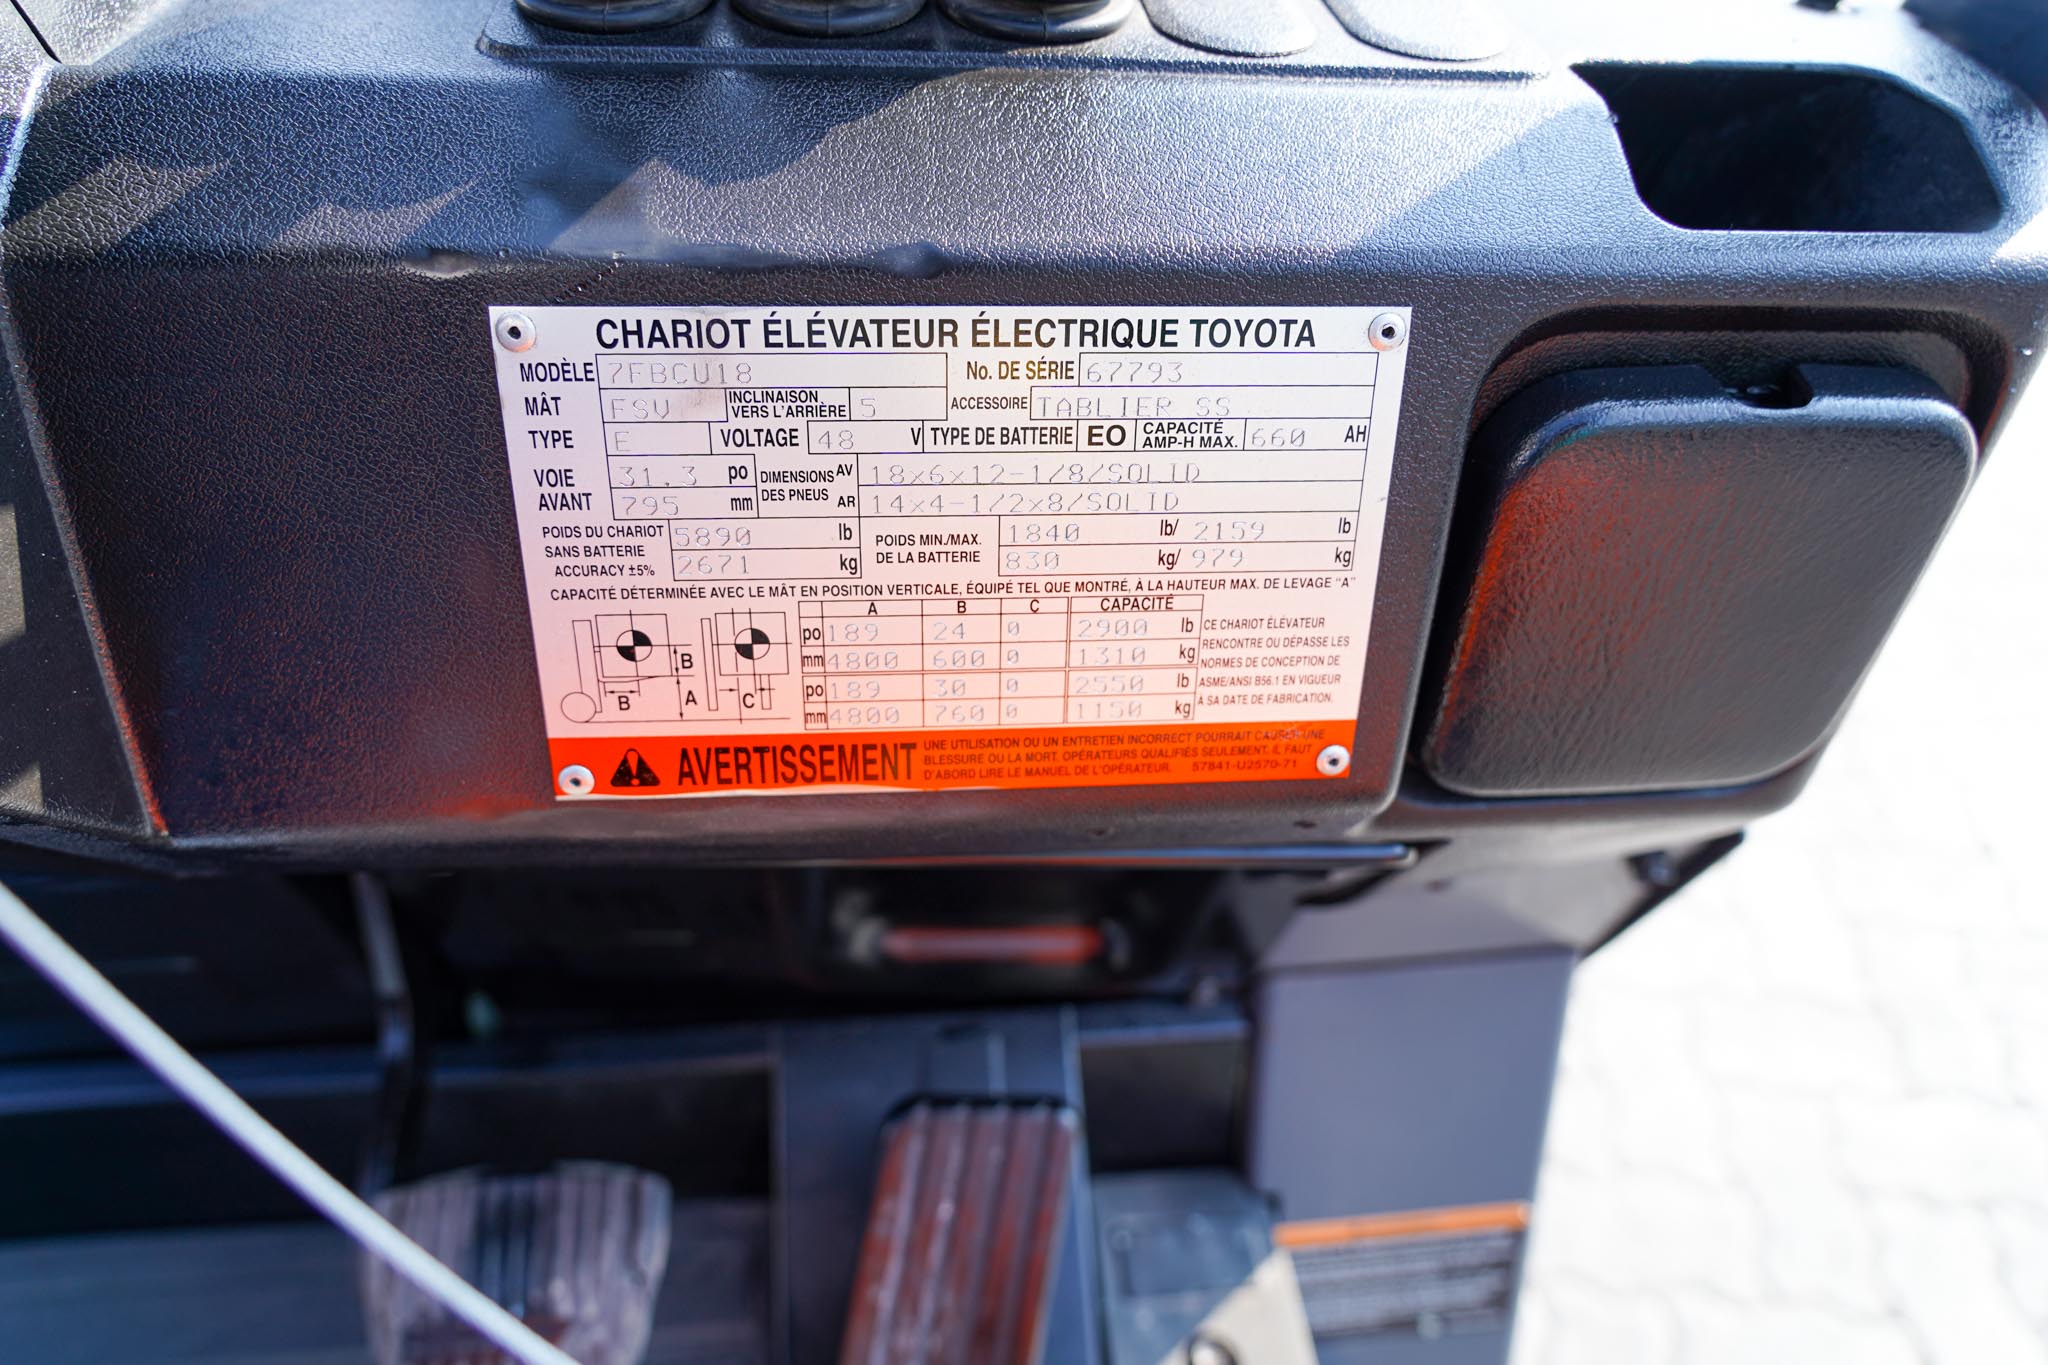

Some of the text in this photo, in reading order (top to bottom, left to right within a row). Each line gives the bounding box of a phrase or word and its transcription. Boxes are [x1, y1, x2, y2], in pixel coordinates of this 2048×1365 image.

[596, 311, 1316, 350] CHARIOT ÉLÉVATEUR ÉLECTRIQUE TOYOTA
[519, 357, 752, 384] MODÈLE 7FBCU18
[966, 356, 1075, 380] No. DE SÉRIE
[1087, 362, 1183, 383] 67793
[524, 391, 670, 420] MÂT FSV
[729, 390, 819, 403] INCLINAISON
[951, 397, 1028, 410] ACCESSOIRE
[732, 402, 847, 418] VERS L'ARRIÈRE
[861, 398, 876, 418] 5
[1038, 396, 1230, 417] TABLIER SS
[930, 424, 1126, 446] TYPE DE BATTERIE EO
[1143, 419, 1223, 434] CAPACITÉ
[1252, 425, 1367, 447] 660 AH
[528, 430, 630, 451] TYPE E
[720, 428, 922, 450] VOLTAGE 48 V
[1142, 436, 1238, 448] AMP-H MAX.
[533, 465, 748, 487] VOIE 31.3 po
[760, 470, 835, 483] DIMENSIONS
[836, 464, 853, 476] AV
[538, 492, 753, 516] AVANT 795 mm
[761, 488, 829, 501] DES PNEUS
[837, 496, 856, 507] AR
[542, 525, 664, 538] POIDS DU CHARIOT
[675, 523, 853, 547] 5890 lb
[875, 533, 982, 546] POIDS MIN./MAX.
[1010, 517, 1351, 543] 1840 lb/ 2159 lb
[545, 545, 645, 558] SANS BATTERIE
[876, 551, 981, 564] DE LA BATTERIE
[1006, 547, 1352, 570] 830 kg/ 979 kg
[555, 564, 655, 577] ACCURACY ±5%
[678, 553, 858, 575] 2671 kg
[550, 585, 616, 601] CAPACITÉ
[620, 584, 706, 600] DÉTERMINÉE
[710, 586, 744, 599] AVEC
[748, 586, 764, 597] LE
[769, 583, 796, 597] MÂT
[801, 585, 818, 597] EN
[822, 584, 883, 597] POSITION
[887, 583, 962, 596] VERTICALE,
[966, 580, 1013, 593] ÉQUIPÉ
[1017, 582, 1040, 593] TEL
[1044, 581, 1071, 594] QUE
[1075, 578, 1131, 594] MONTRÉ,
[1135, 577, 1144, 592] À
[1147, 580, 1163, 591] LA
[1167, 579, 1226, 591] HAUTEUR
[1230, 578, 1259, 589] MAX.
[1263, 578, 1280, 589] DE
[1283, 577, 1332, 589] LEVAGE
[867, 594, 1174, 615] A B C CAPACITÉ
[802, 627, 821, 644] po
[828, 623, 879, 642] 189
[933, 622, 966, 641] 24
[1078, 618, 1148, 638] 2900
[1181, 617, 1194, 633] lb
[1203, 615, 1325, 630] CE CHARIOT ÉLÉVATEUR
[1202, 634, 1350, 650] RENCONTRE OU DÉPASSE LES
[680, 653, 693, 669] B
[802, 654, 824, 667] mm
[827, 651, 898, 671] 4800
[933, 650, 985, 669] 600
[1080, 647, 1146, 666] 1310
[1179, 643, 1196, 663] kg
[1201, 655, 1340, 669] NORMES DE CONCEPTION DE
[805, 683, 824, 700] po
[831, 681, 880, 700] 189
[935, 679, 966, 697] 30
[1177, 673, 1189, 688] lb
[1282, 675, 1295, 685] EN
[1298, 674, 1341, 685] VIGUEUR
[618, 695, 630, 711] B
[685, 690, 698, 706] A
[742, 693, 755, 709] C
[1222, 694, 1248, 705] DATE
[1251, 694, 1264, 704] DE
[805, 710, 827, 724] mm
[829, 706, 900, 725] 4800
[935, 704, 985, 724] 760
[1175, 700, 1191, 718] kg
[924, 740, 947, 751] UNE
[950, 737, 1020, 750] UTILISATION
[1023, 736, 1040, 748] OU
[1043, 736, 1059, 747] UN
[1062, 735, 1124, 747] ENTRETIEN
[1127, 732, 1192, 745] INCORRECT
[678, 741, 917, 786] AVERTISSEMENT
